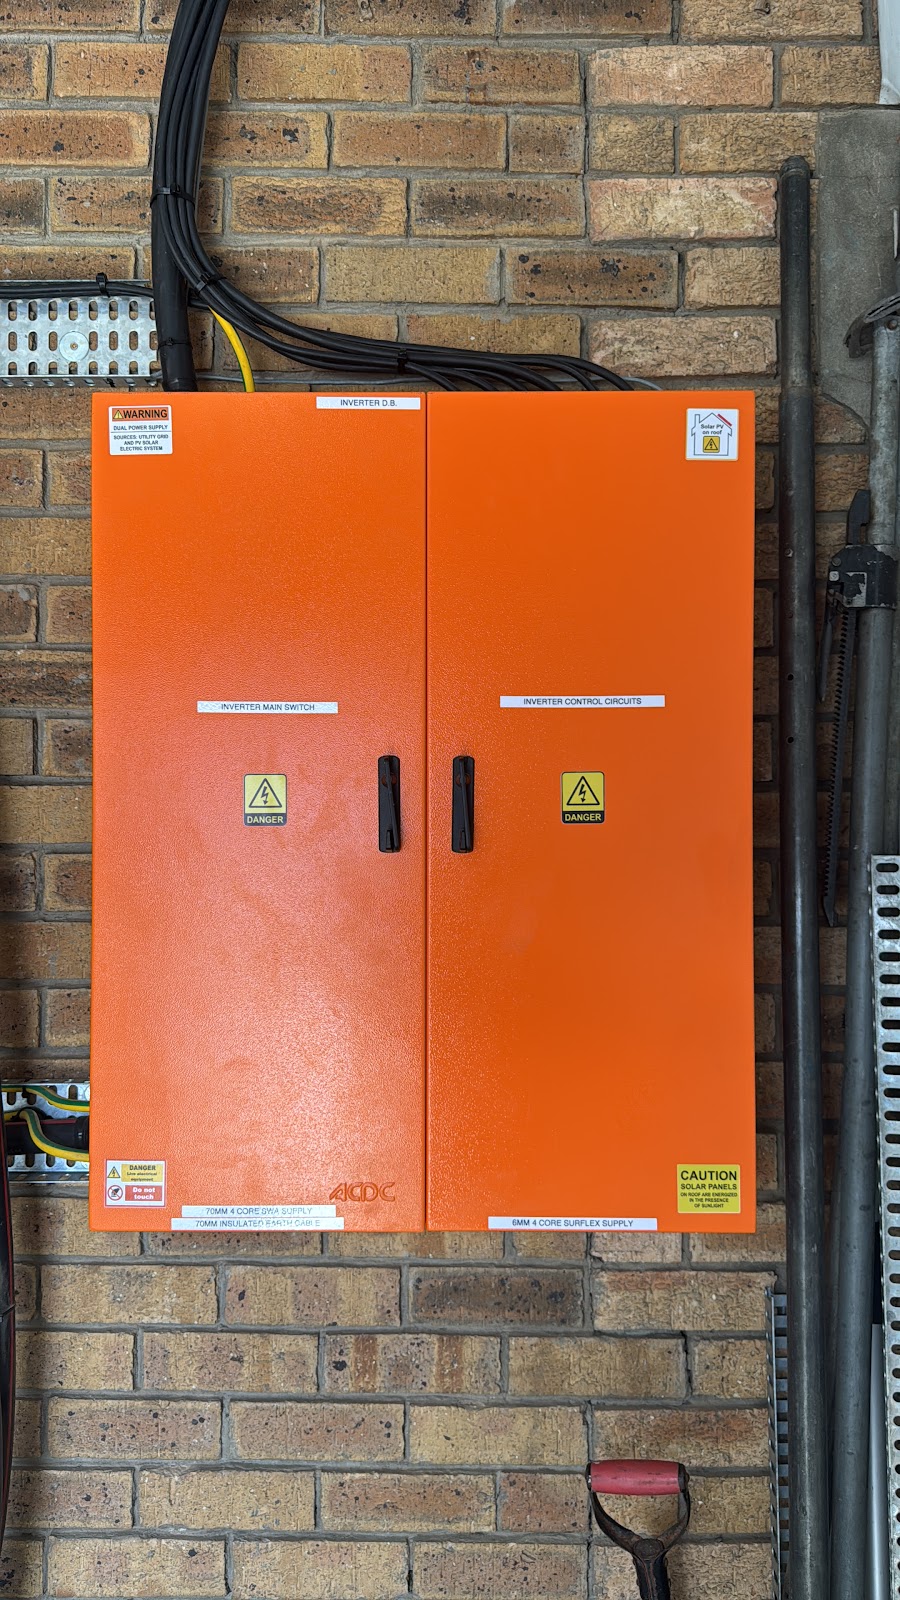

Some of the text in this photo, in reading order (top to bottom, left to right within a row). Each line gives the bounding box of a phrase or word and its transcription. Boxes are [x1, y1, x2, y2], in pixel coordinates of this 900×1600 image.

[123, 409, 168, 418] WARNING
[680, 1170, 737, 1180] CAUTION
[329, 1182, 395, 1202] ACDC
